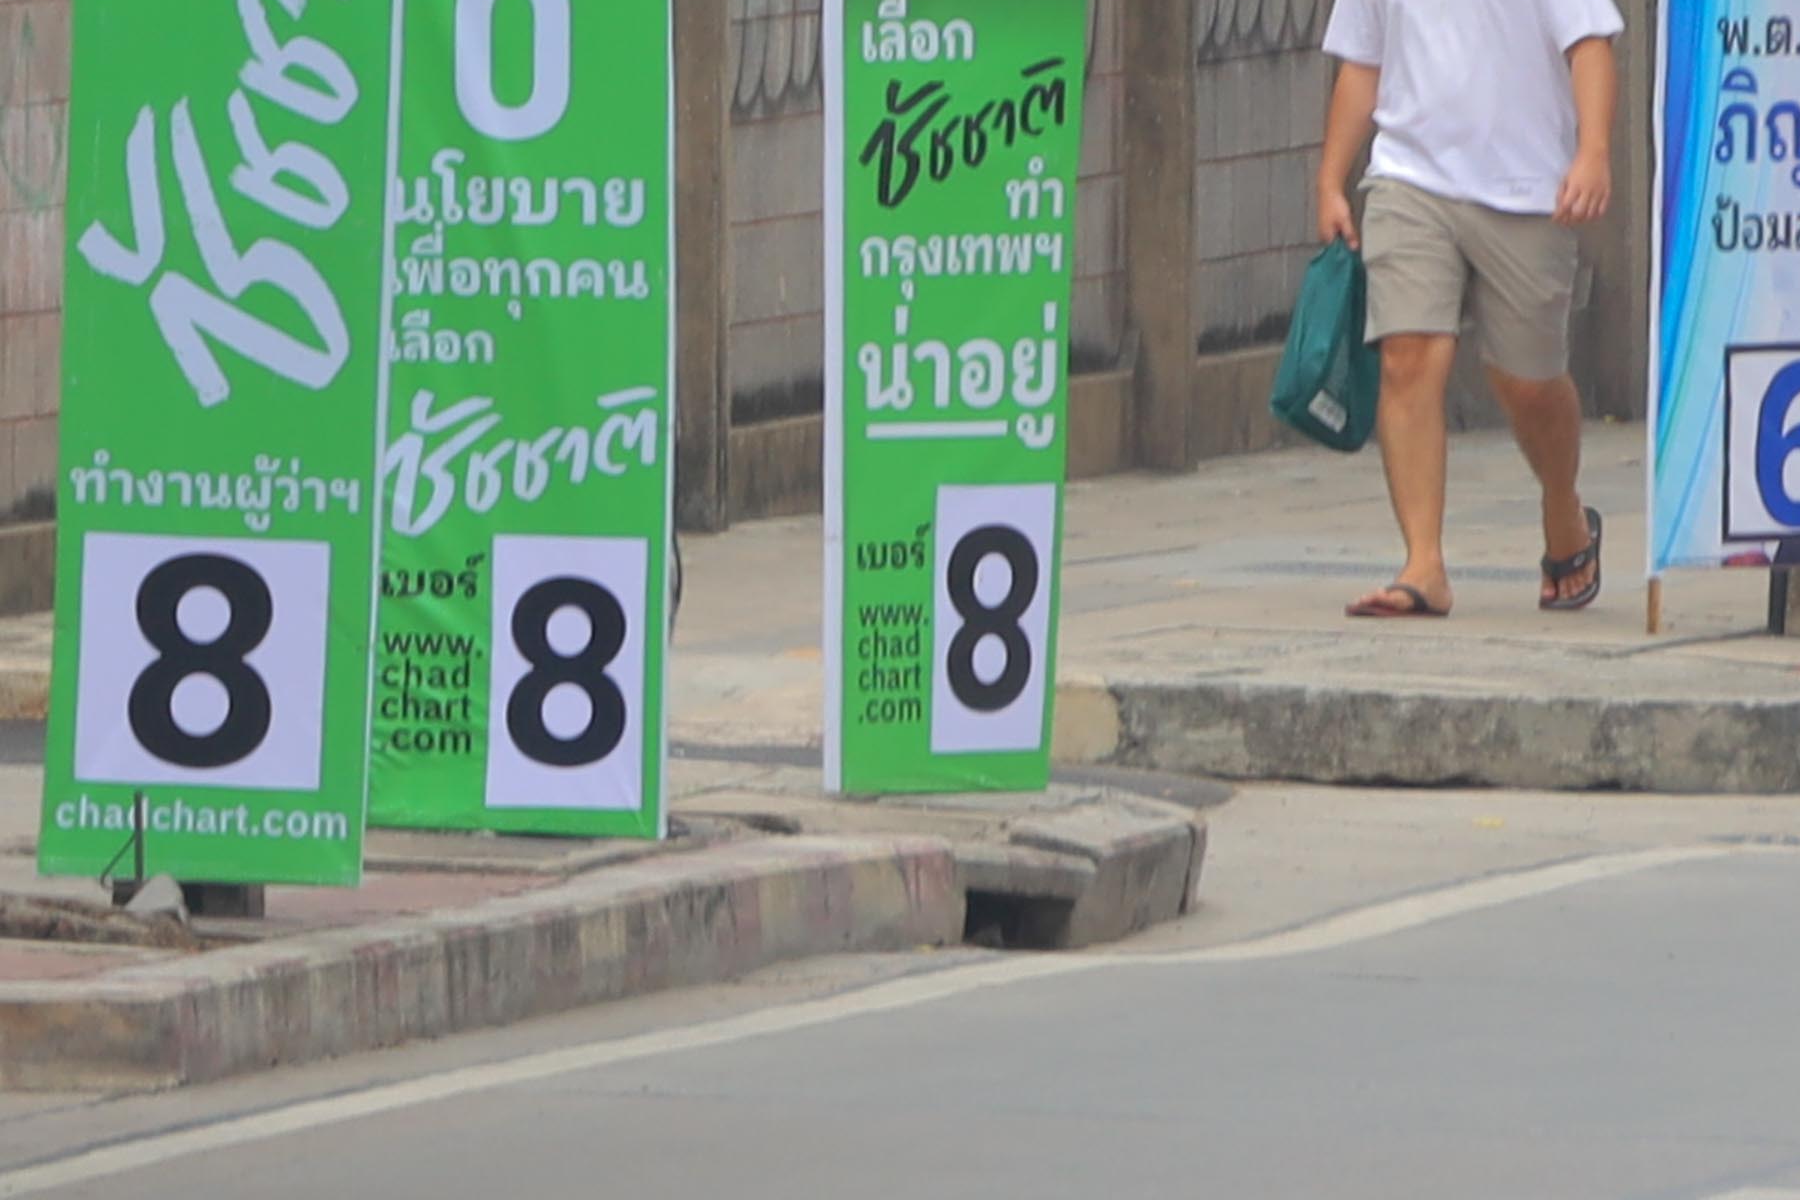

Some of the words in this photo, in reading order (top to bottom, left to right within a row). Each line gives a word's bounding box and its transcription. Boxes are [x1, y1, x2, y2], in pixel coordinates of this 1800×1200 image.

[859, 57, 1066, 208] ชัชชาติ
[392, 147, 646, 227] นโยบาย
[1006, 156, 1064, 219] ทำ
[860, 232, 1063, 301] กรุงเทพฯ
[858, 301, 1059, 449] น่าอยู่
[69, 449, 360, 532] ทำงานผู้ว่าฯ
[383, 386, 658, 537] ชัชชาติ
[384, 633, 483, 660] www.
[857, 522, 932, 571] เบอร์
[946, 523, 1040, 714] 8
[858, 628, 920, 660] chad
[859, 604, 929, 626] www.
[127, 551, 273, 769] 8
[380, 658, 470, 690] chad
[381, 552, 486, 599] เบอร์
[506, 575, 627, 769] 8
[858, 663, 921, 692] chart
[380, 692, 472, 722] chart
[858, 697, 921, 724] .com
[382, 726, 472, 755] .com
[55, 793, 348, 840] chadchart.com
